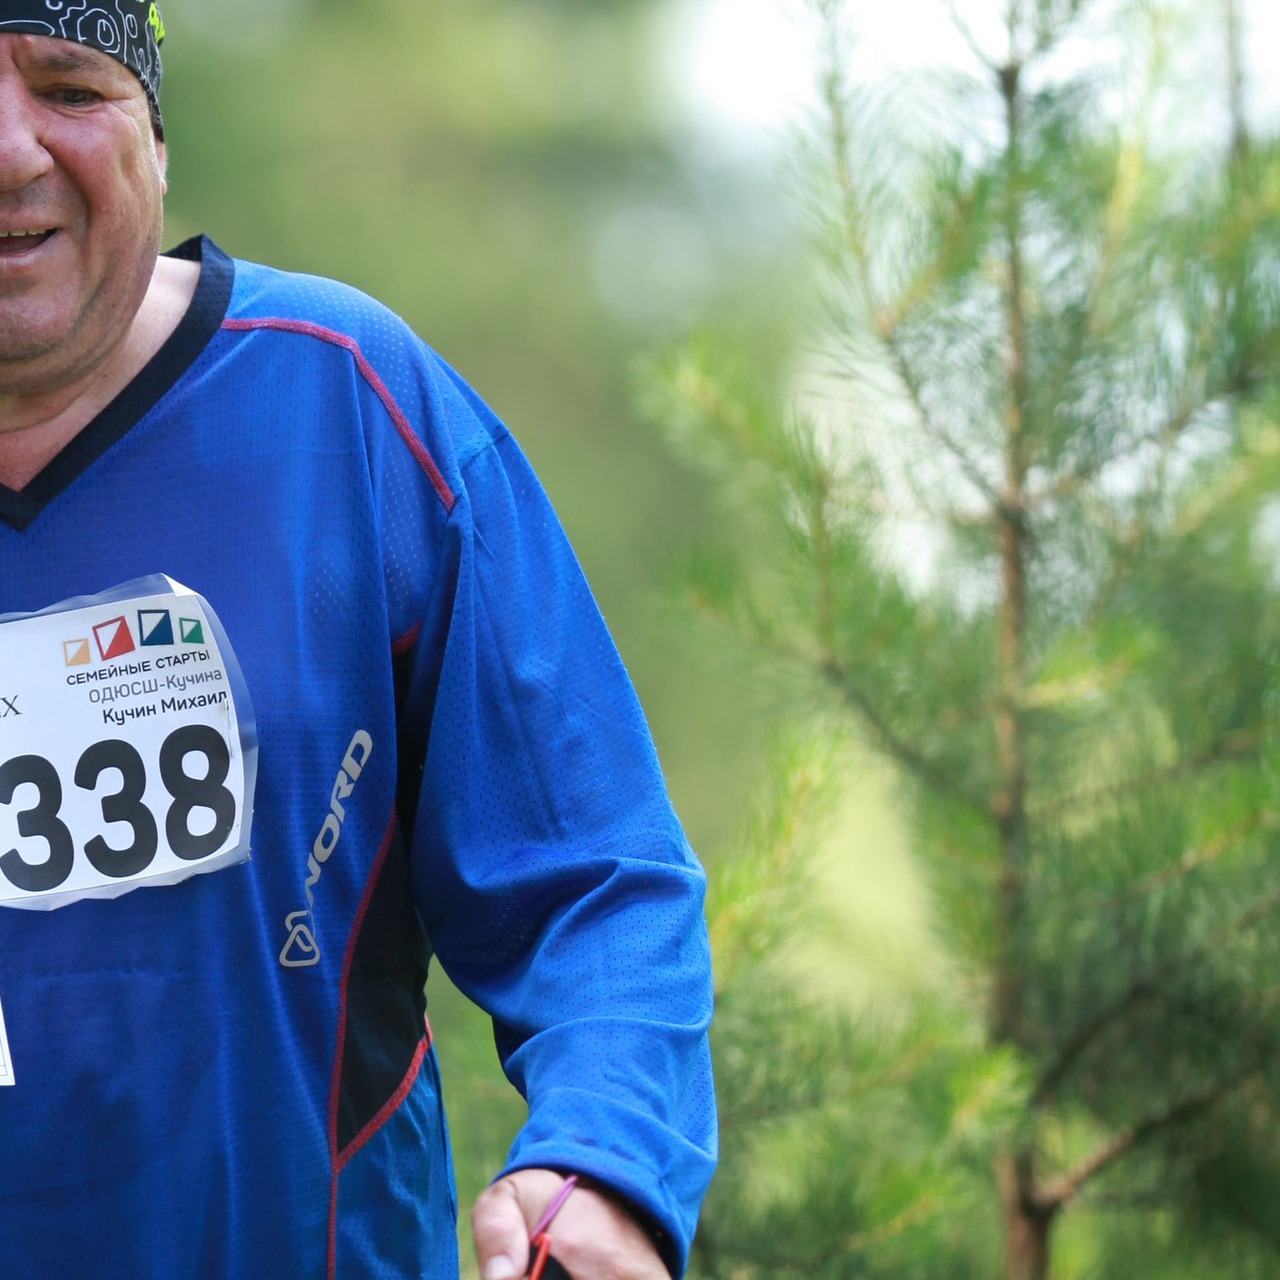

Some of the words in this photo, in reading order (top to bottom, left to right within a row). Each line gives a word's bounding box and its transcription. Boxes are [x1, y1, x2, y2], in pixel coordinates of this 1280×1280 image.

[66, 660, 152, 686] СЕМЕЙНЫЕ
[155, 649, 210, 669] СТАРТЫ
[89, 669, 223, 704] ОДЮСШ-Кучина
[103, 704, 157, 726] Кучин
[161, 690, 228, 713] Михаил
